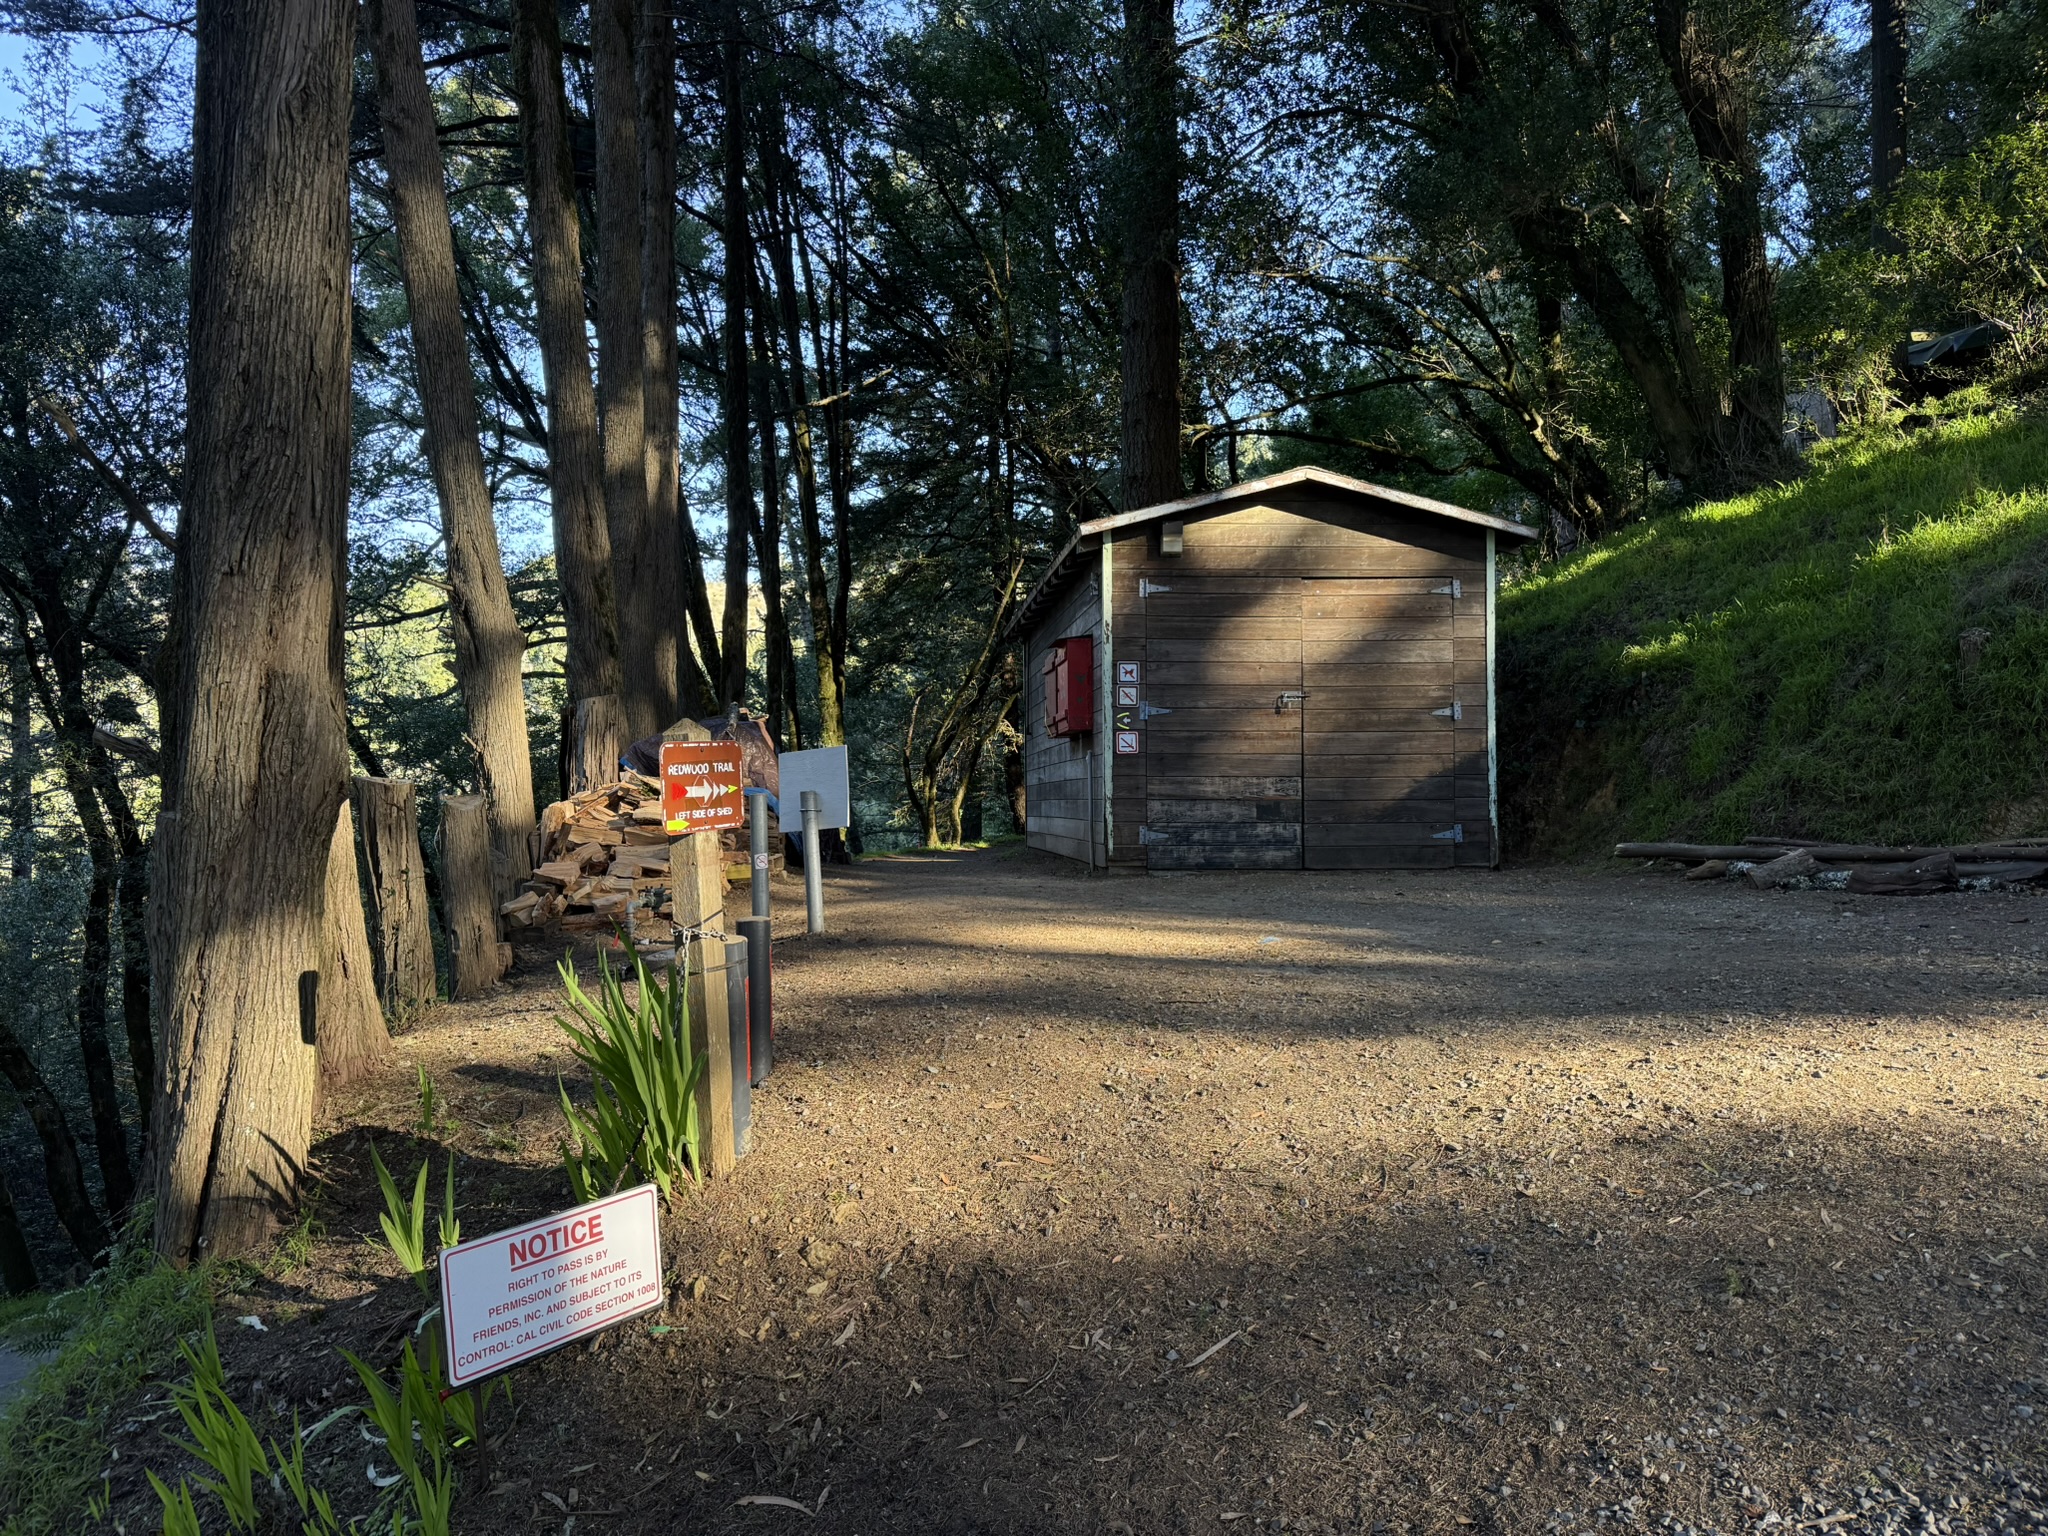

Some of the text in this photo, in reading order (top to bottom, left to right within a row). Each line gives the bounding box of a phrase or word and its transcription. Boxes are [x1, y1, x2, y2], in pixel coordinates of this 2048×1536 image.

[668, 762, 735, 775] REDWOOD TRAIL
[675, 807, 732, 820] LEFT SIDE OF SHED
[509, 1214, 604, 1266] NOTICE
[489, 1259, 627, 1318] PERMISSION OF THE NATURE
[508, 1249, 608, 1292] RIGHT TO PASS IS BY
[458, 1283, 656, 1367] CONTROL: CAL CIVIL CODE SECTION 1008
[473, 1271, 642, 1342] FRIENDS, INC. AND SUBJECT TO ITS
